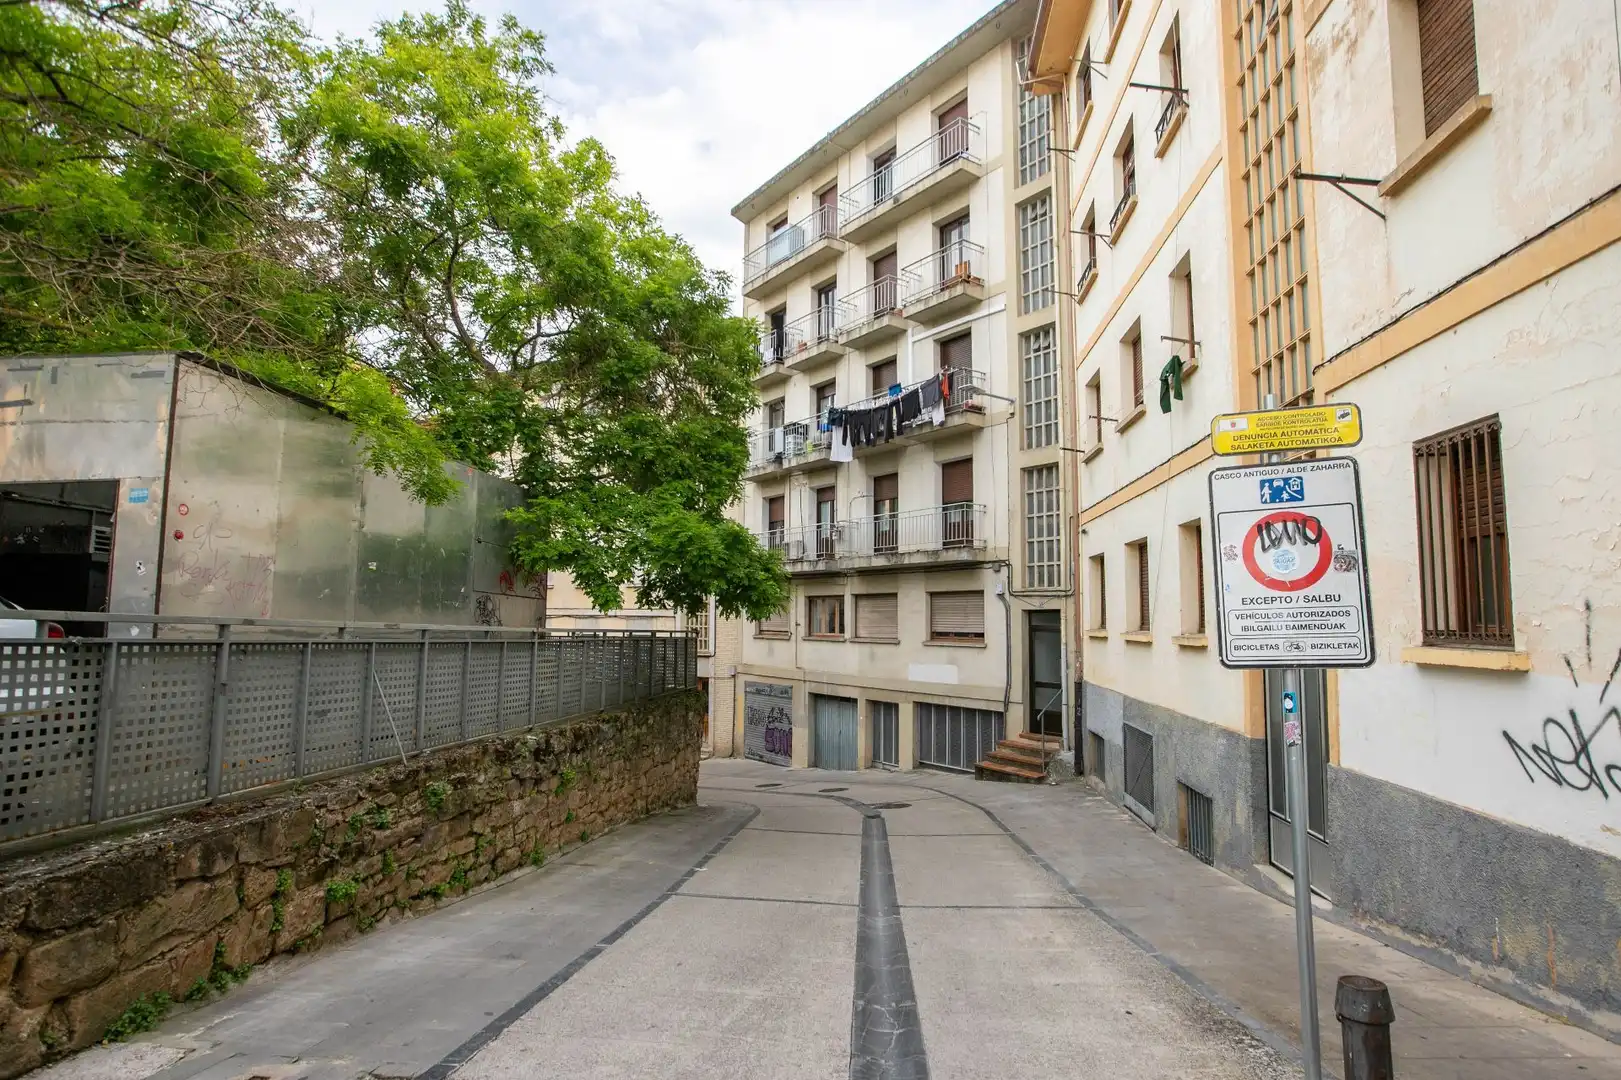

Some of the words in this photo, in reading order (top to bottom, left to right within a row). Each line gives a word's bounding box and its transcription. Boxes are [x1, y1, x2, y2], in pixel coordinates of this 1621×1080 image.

[1232, 432, 1278, 442] DENUNCIA
[1230, 441, 1276, 451] SALAKETA
[1277, 436, 1344, 448] AUTOMATIKOA
[1214, 473, 1242, 481] CASCO
[1243, 469, 1279, 478] ANTIGUO
[1286, 466, 1308, 474] ALDE
[1310, 462, 1351, 473] ZAHARRA
[1241, 595, 1293, 606] EXCEPTO
[1295, 595, 1300, 604] /
[1303, 594, 1341, 603] SALBU
[1286, 609, 1351, 619] AUTORIZADOS
[1241, 623, 1283, 632] IBILGAILU
[1285, 622, 1347, 631] BAIMENDUAK
[1233, 643, 1280, 651] BICICLETAS
[1310, 642, 1359, 650] BIZIKLETAK
